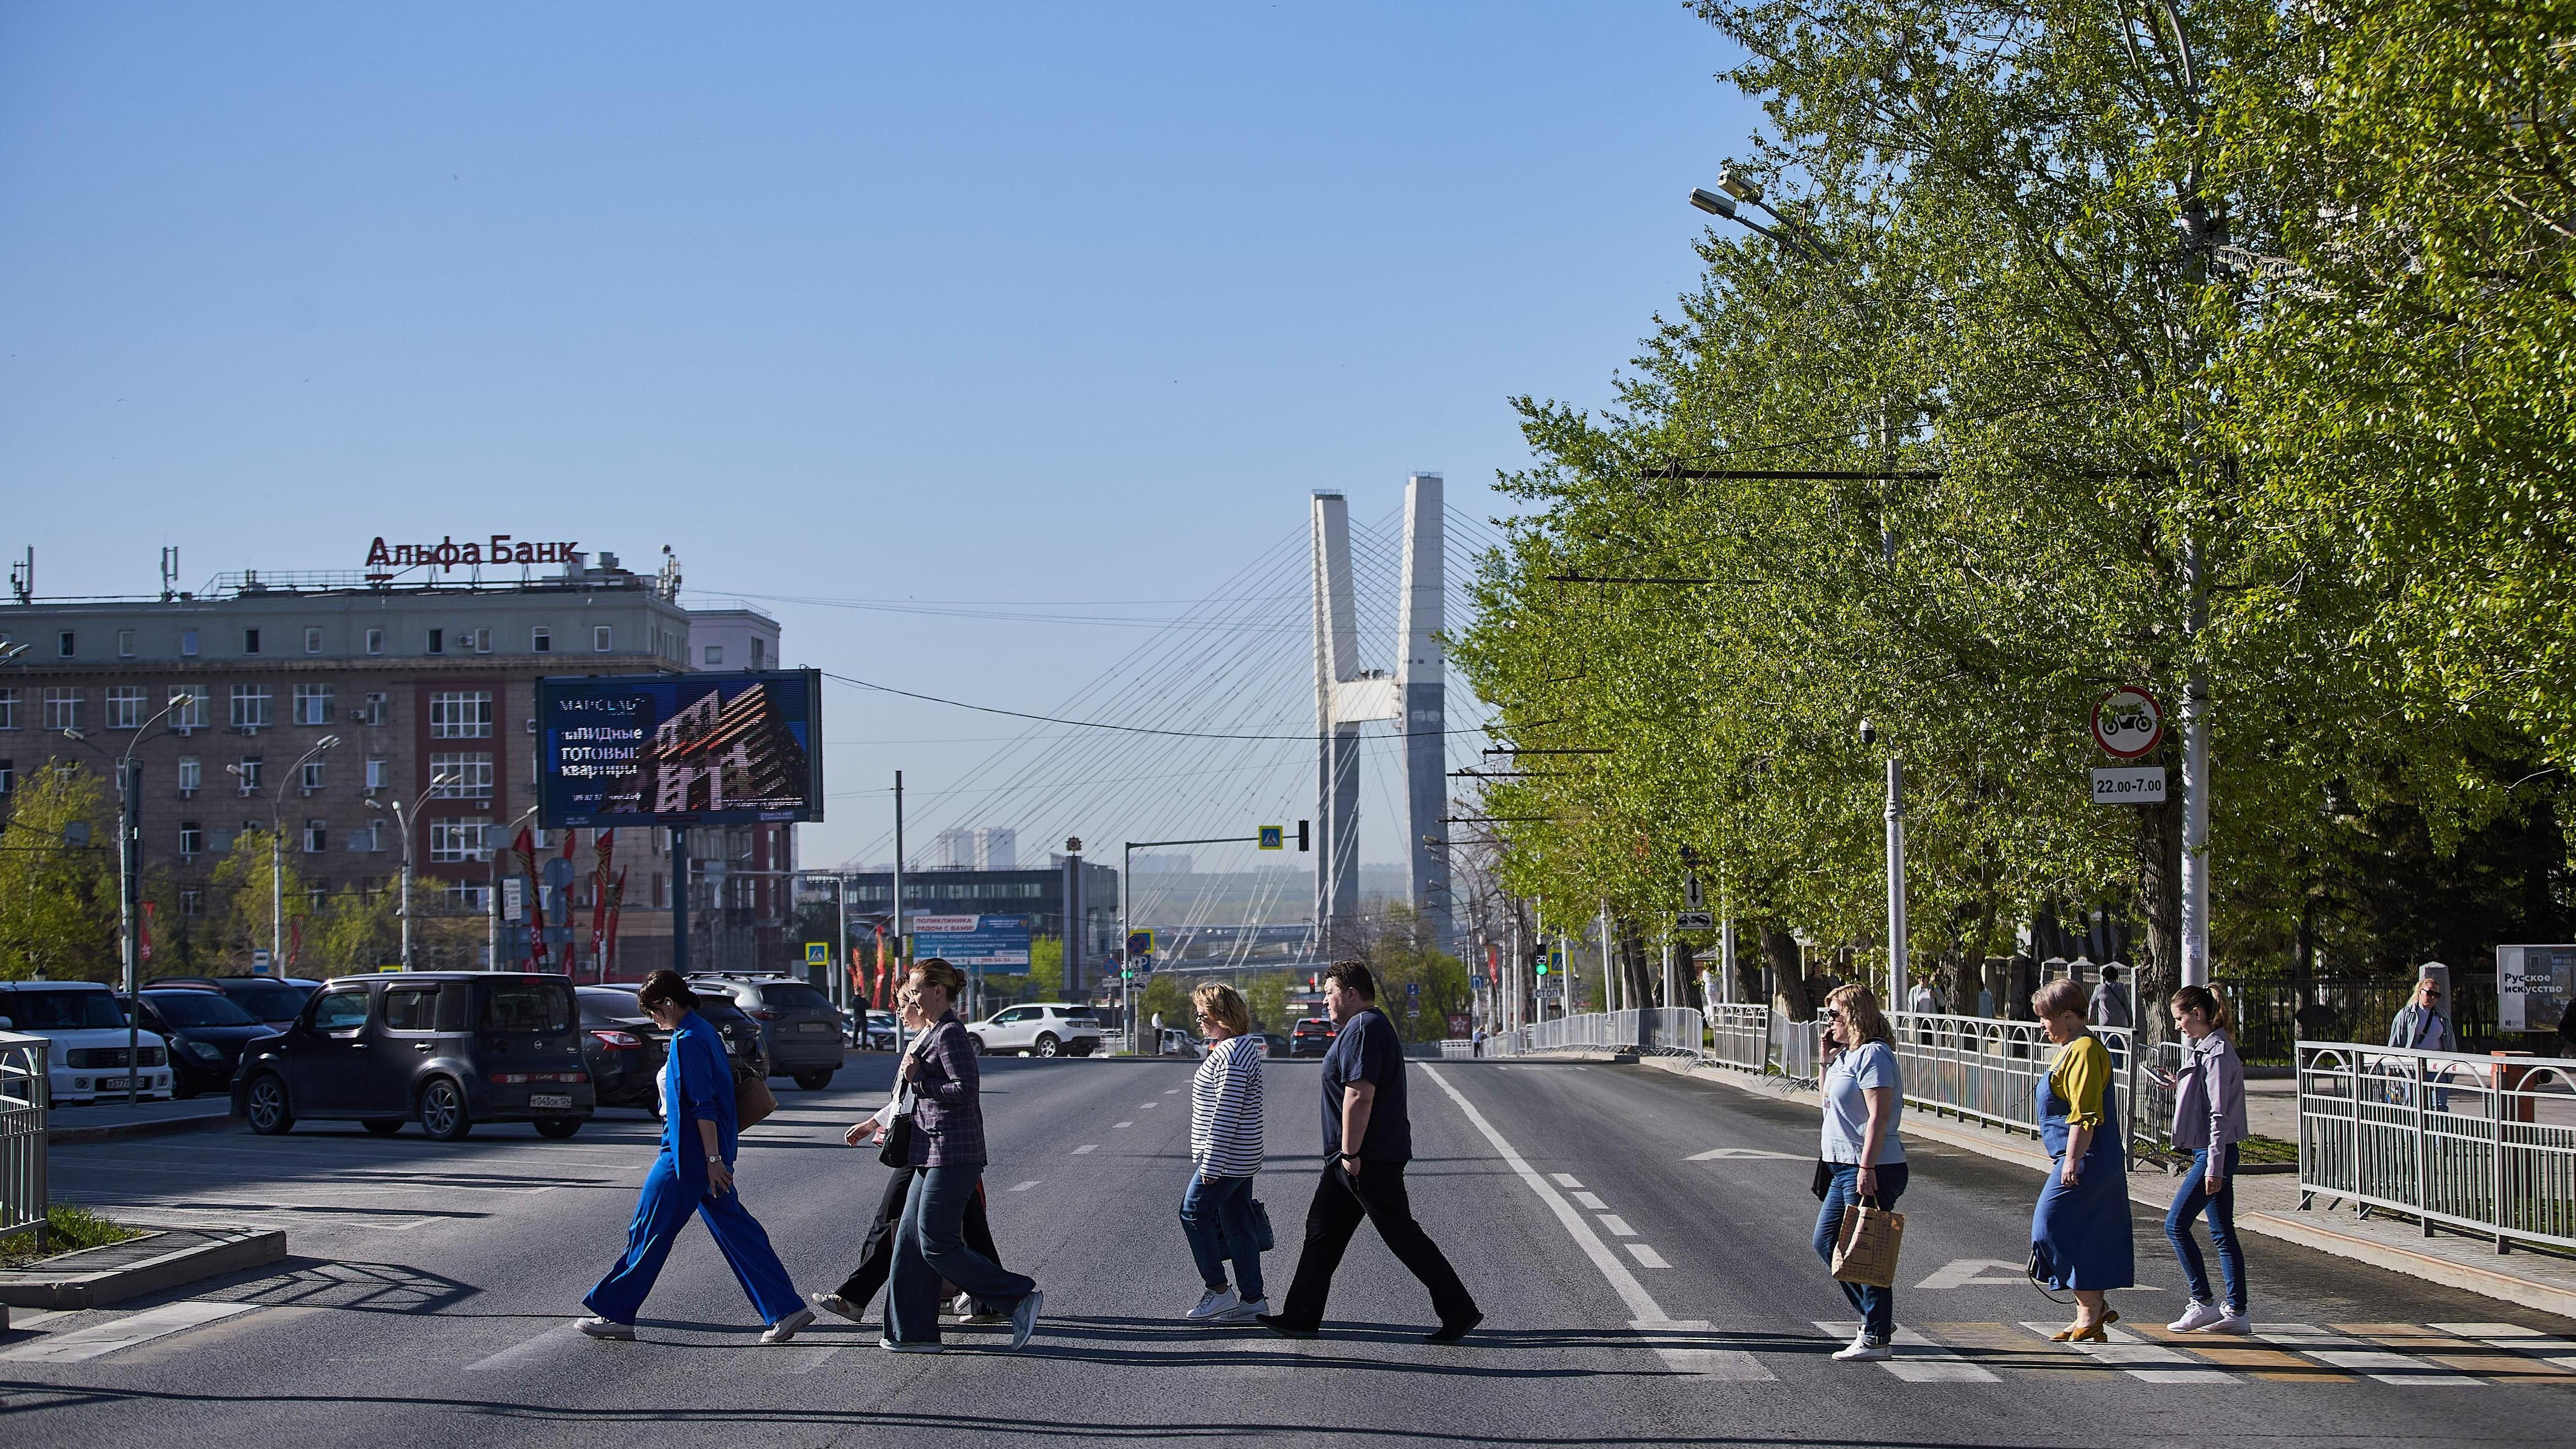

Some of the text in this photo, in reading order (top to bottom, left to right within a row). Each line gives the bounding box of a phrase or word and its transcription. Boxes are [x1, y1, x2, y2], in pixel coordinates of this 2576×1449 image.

[365, 535, 578, 573] Альфа Банк
[2097, 778, 2162, 794] 22.00-7.00
[1537, 955, 1547, 964] 29
[2504, 973, 2551, 984] Русское
[1535, 989, 1558, 997] СТОП
[2504, 985, 2563, 995] искусство
